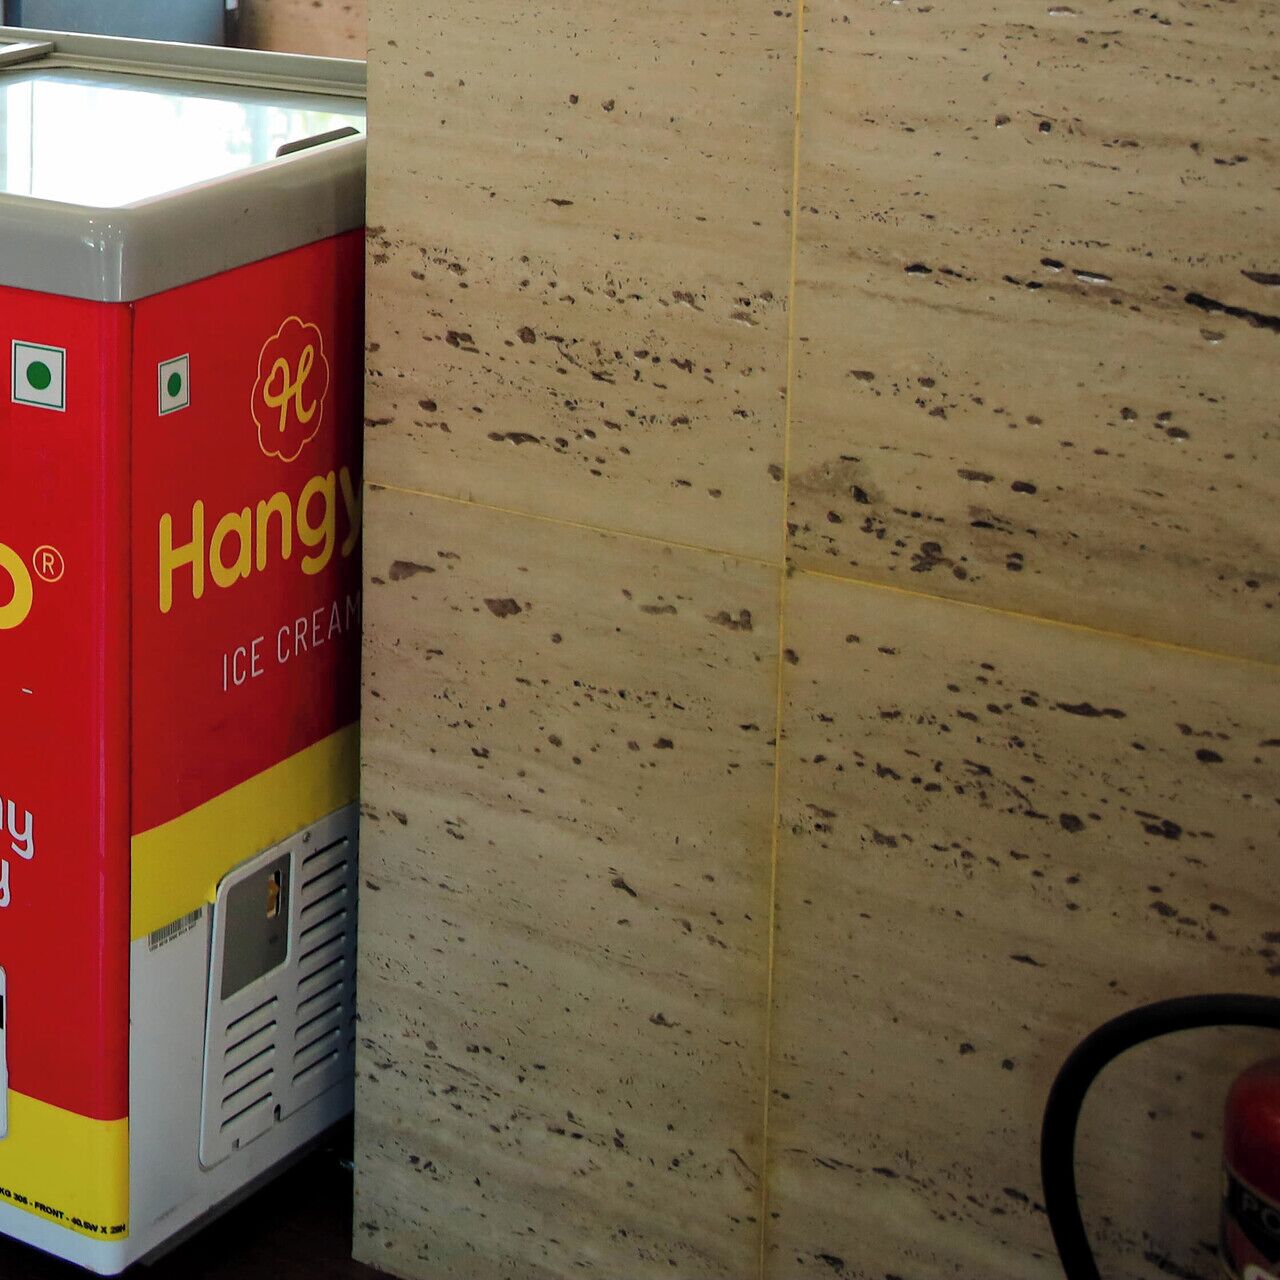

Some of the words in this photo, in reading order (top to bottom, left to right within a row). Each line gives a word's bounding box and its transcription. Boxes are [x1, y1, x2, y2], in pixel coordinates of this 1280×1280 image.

[223, 636, 265, 691] ICE
[276, 590, 361, 664] CREAM
[34, 1201, 65, 1220] FRONT
